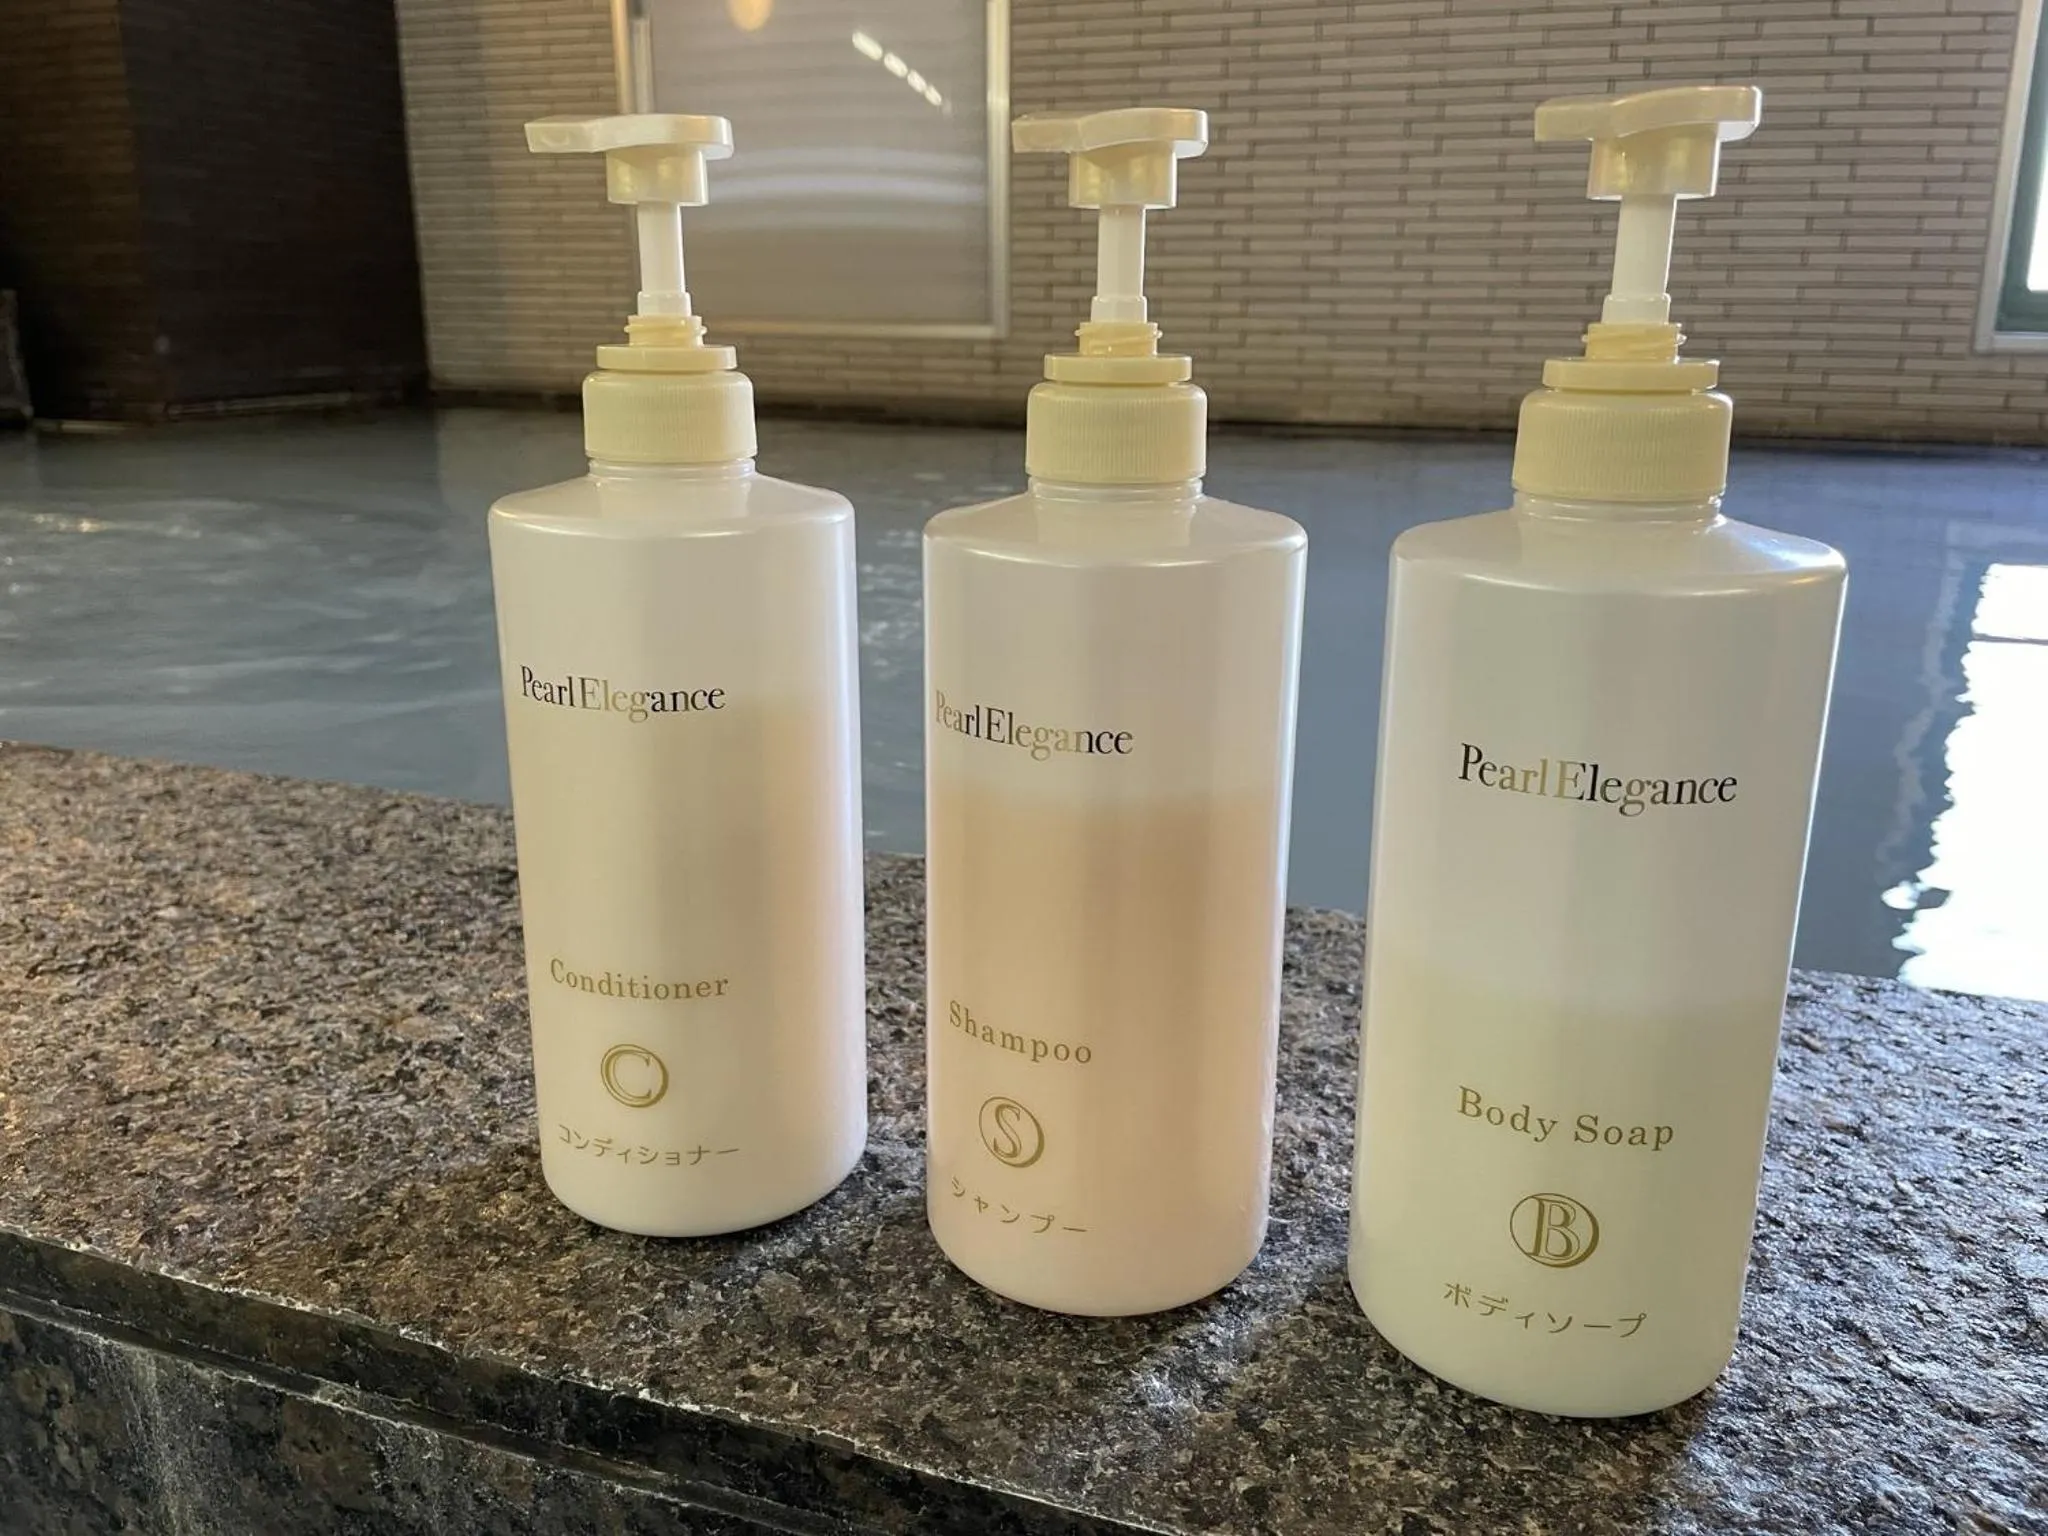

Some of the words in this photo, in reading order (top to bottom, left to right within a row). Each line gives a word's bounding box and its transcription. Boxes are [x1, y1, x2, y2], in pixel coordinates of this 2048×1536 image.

[550, 958, 729, 1000] Conditioner
[949, 1000, 1092, 1064] Shampoo
[558, 1124, 740, 1166] コンディショナー
[1457, 1085, 1560, 1143] Body
[1574, 1114, 1674, 1152] Soap
[951, 1176, 1088, 1233] シャンプー
[1523, 1195, 1581, 1261] B
[1443, 1282, 1648, 1338] ボディソープ
